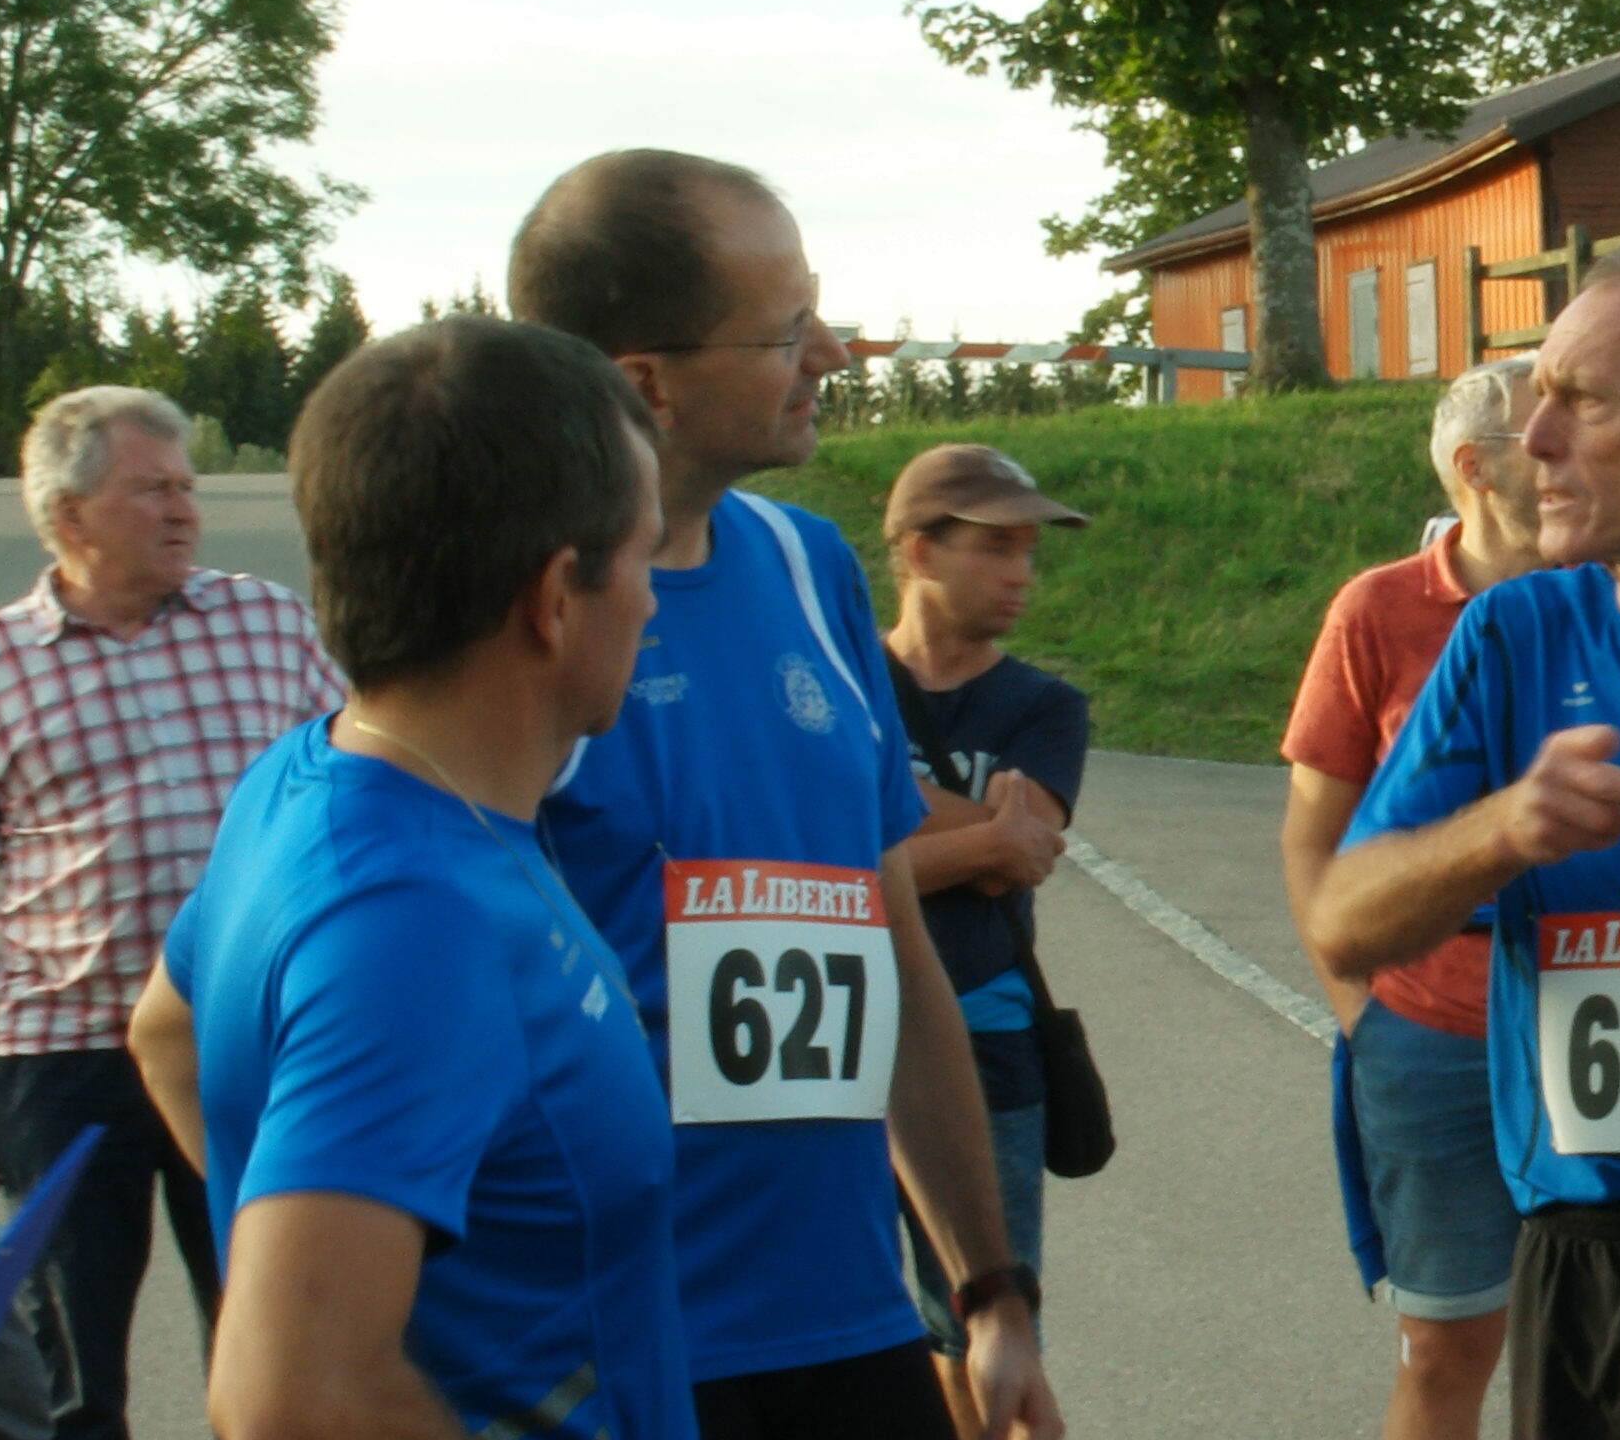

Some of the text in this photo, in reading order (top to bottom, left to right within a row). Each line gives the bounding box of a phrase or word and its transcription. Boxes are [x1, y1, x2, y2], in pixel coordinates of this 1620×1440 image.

[681, 868, 872, 920] LA LIBERTÉ
[1551, 928, 1597, 965] LA
[709, 947, 867, 1086] 627
